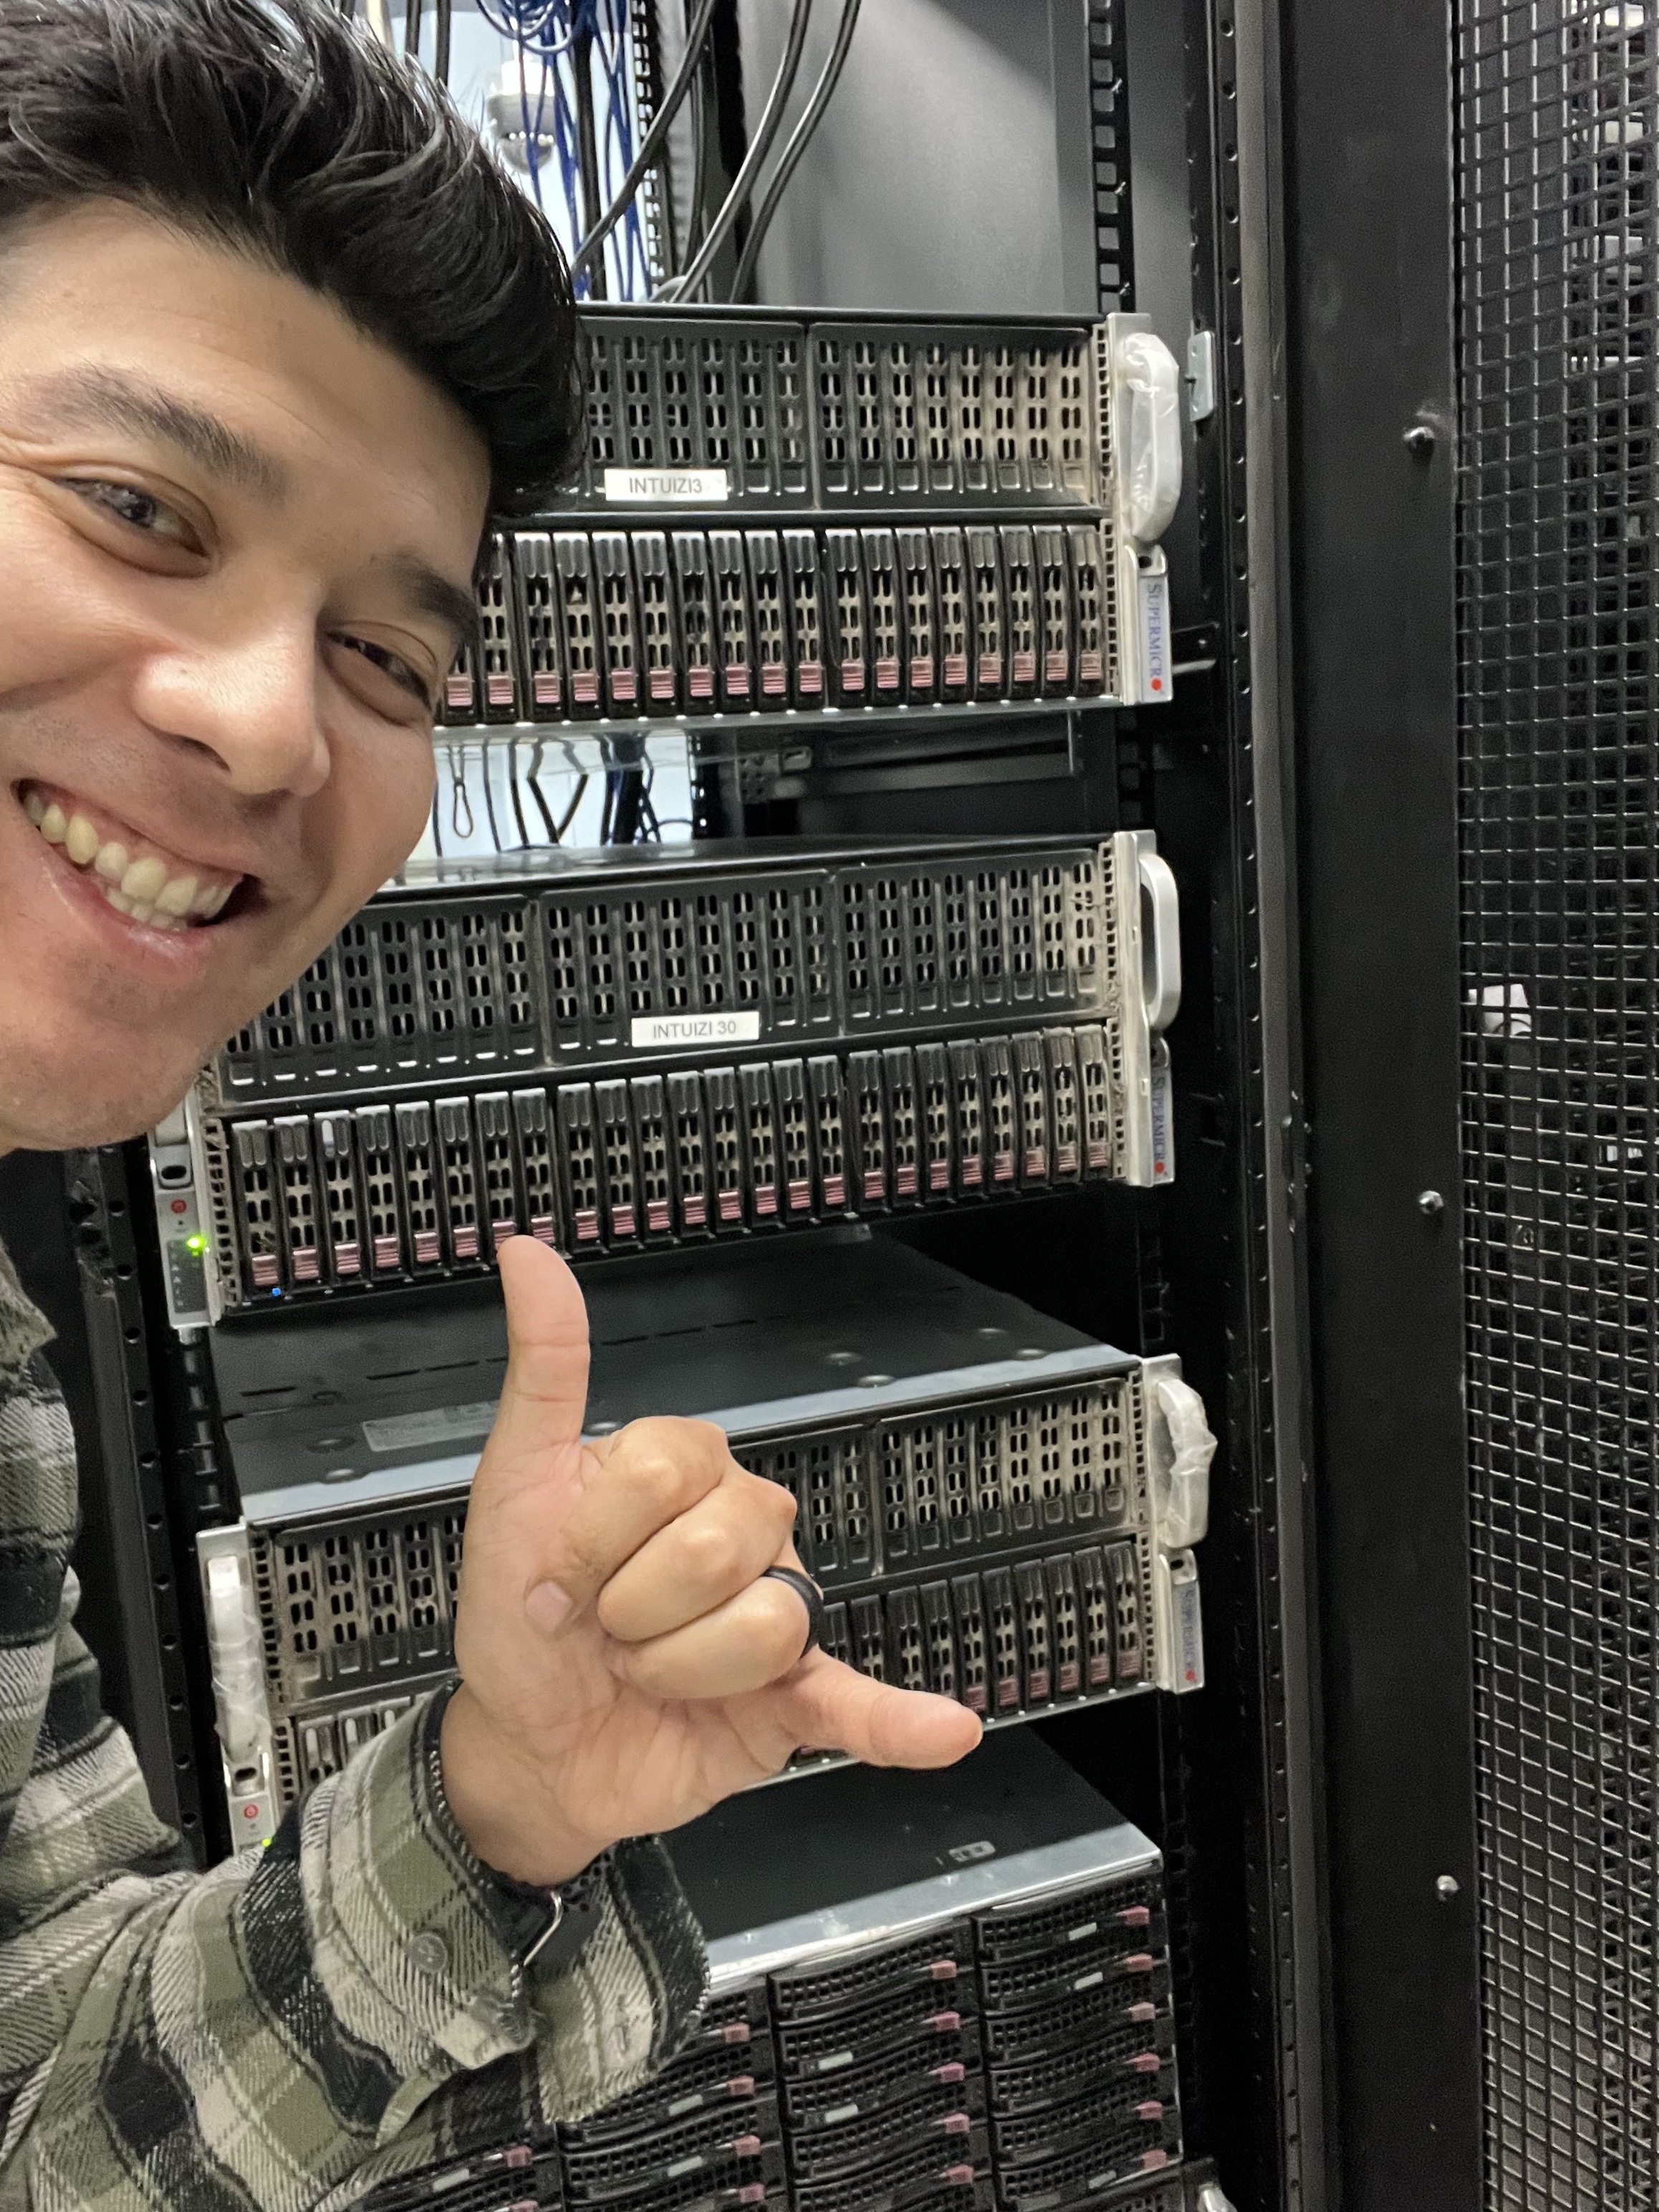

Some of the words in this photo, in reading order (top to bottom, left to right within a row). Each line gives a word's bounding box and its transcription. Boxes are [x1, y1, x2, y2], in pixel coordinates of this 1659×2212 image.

[630, 478, 703, 493] INTUIZI3
[653, 1021, 712, 1039] INTUIZI
[717, 1020, 736, 1035] 30
